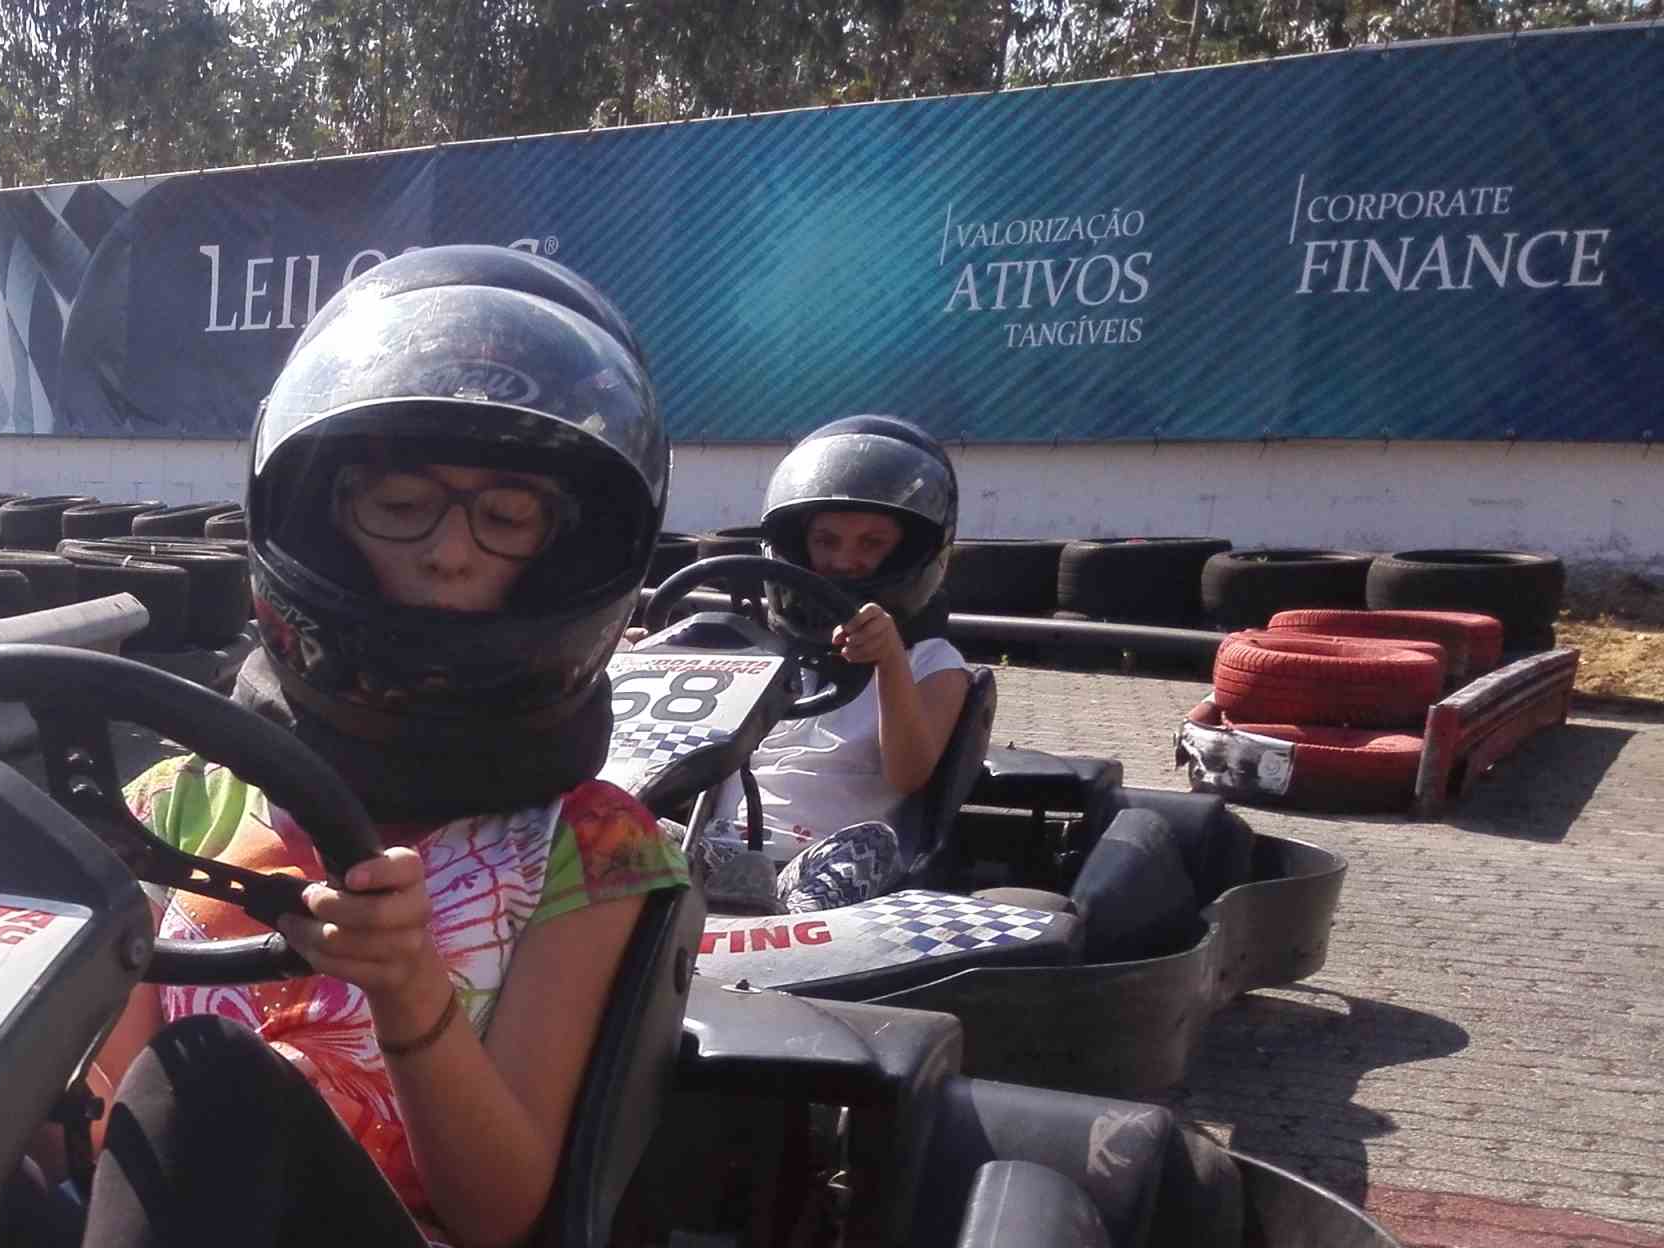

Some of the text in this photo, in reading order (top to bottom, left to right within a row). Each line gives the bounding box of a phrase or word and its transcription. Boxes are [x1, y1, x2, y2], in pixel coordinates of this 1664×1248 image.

[1307, 186, 1513, 223] CORPORATE
[956, 208, 1145, 247] VALORIZAÇÃO
[1296, 229, 1611, 294] FINANCE
[943, 251, 1152, 313] ATIVOS
[1004, 315, 1143, 349] TANGÍVEIS
[612, 669, 734, 723] 68
[698, 921, 832, 954] TING
